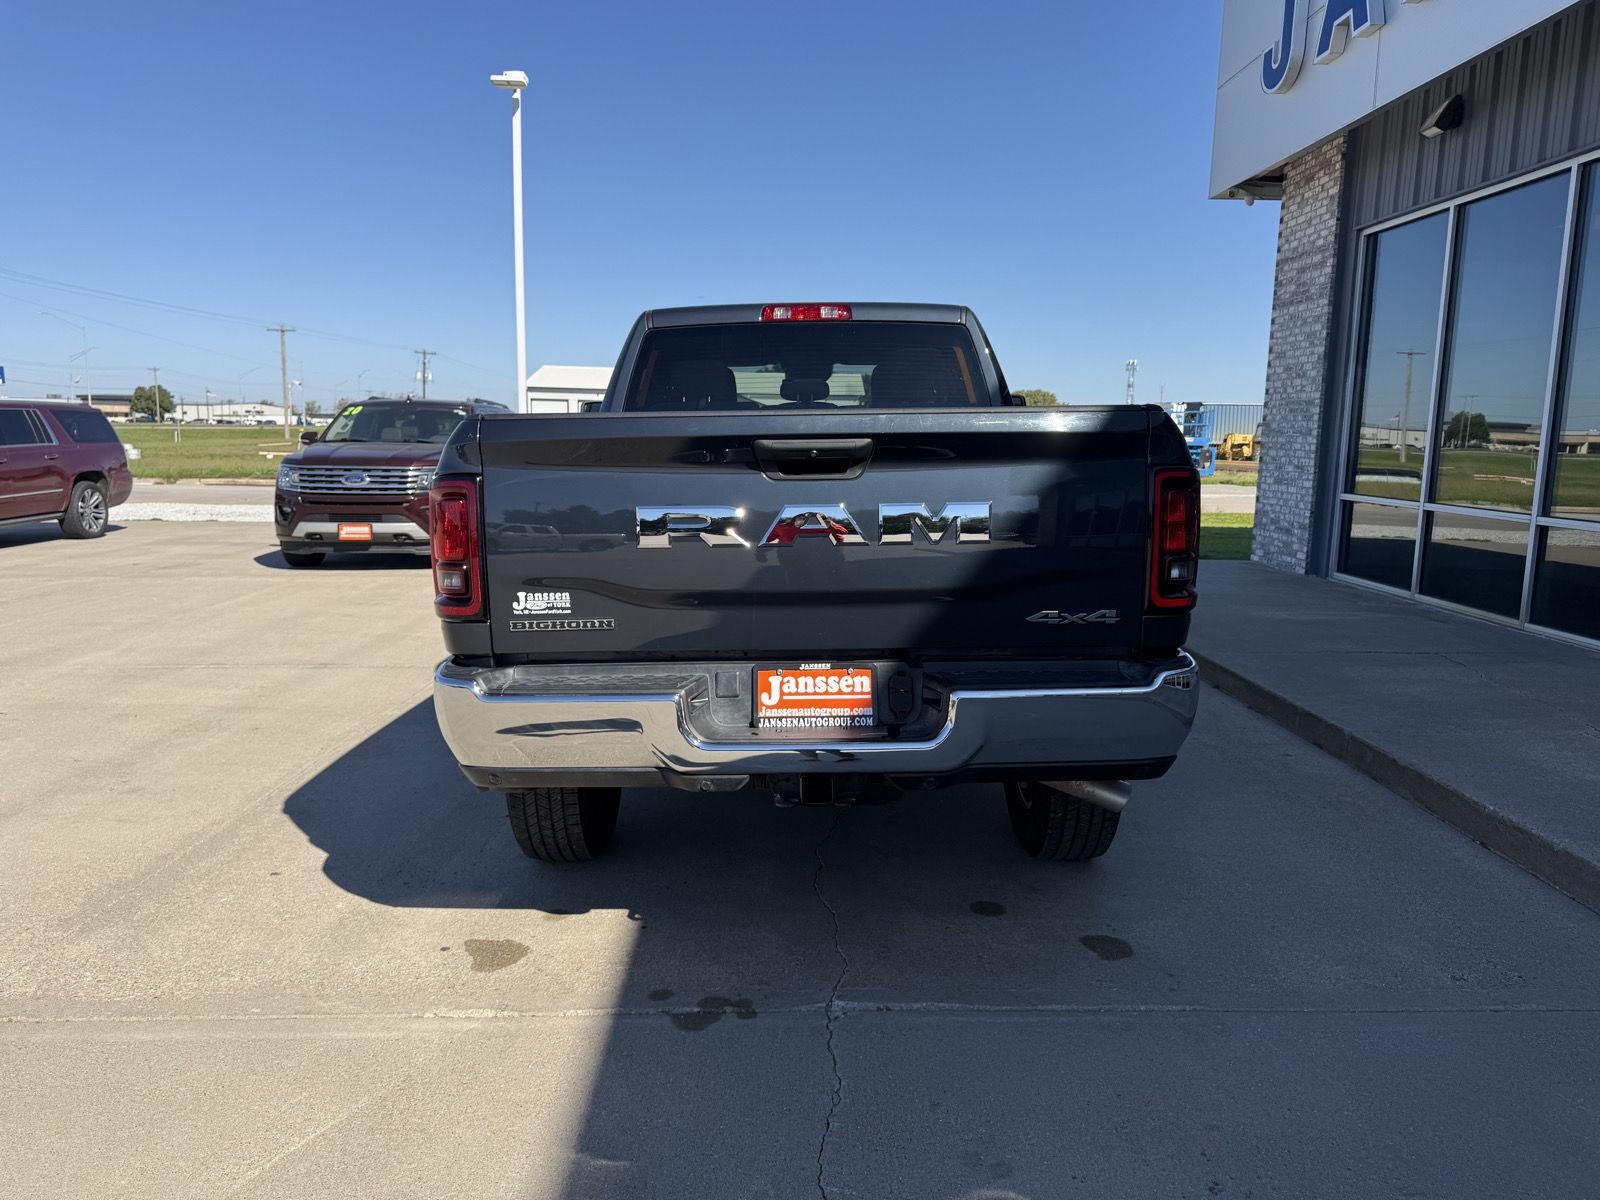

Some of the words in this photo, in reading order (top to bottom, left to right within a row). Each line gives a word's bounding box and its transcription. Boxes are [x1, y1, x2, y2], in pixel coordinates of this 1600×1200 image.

[635, 501, 993, 549] RAM
[512, 591, 571, 610] Janssen
[510, 619, 615, 631] BIGHORN
[1025, 609, 1121, 625] 4x4
[760, 674, 871, 706] Janssen
[758, 706, 873, 717] Janssenautogroup.com
